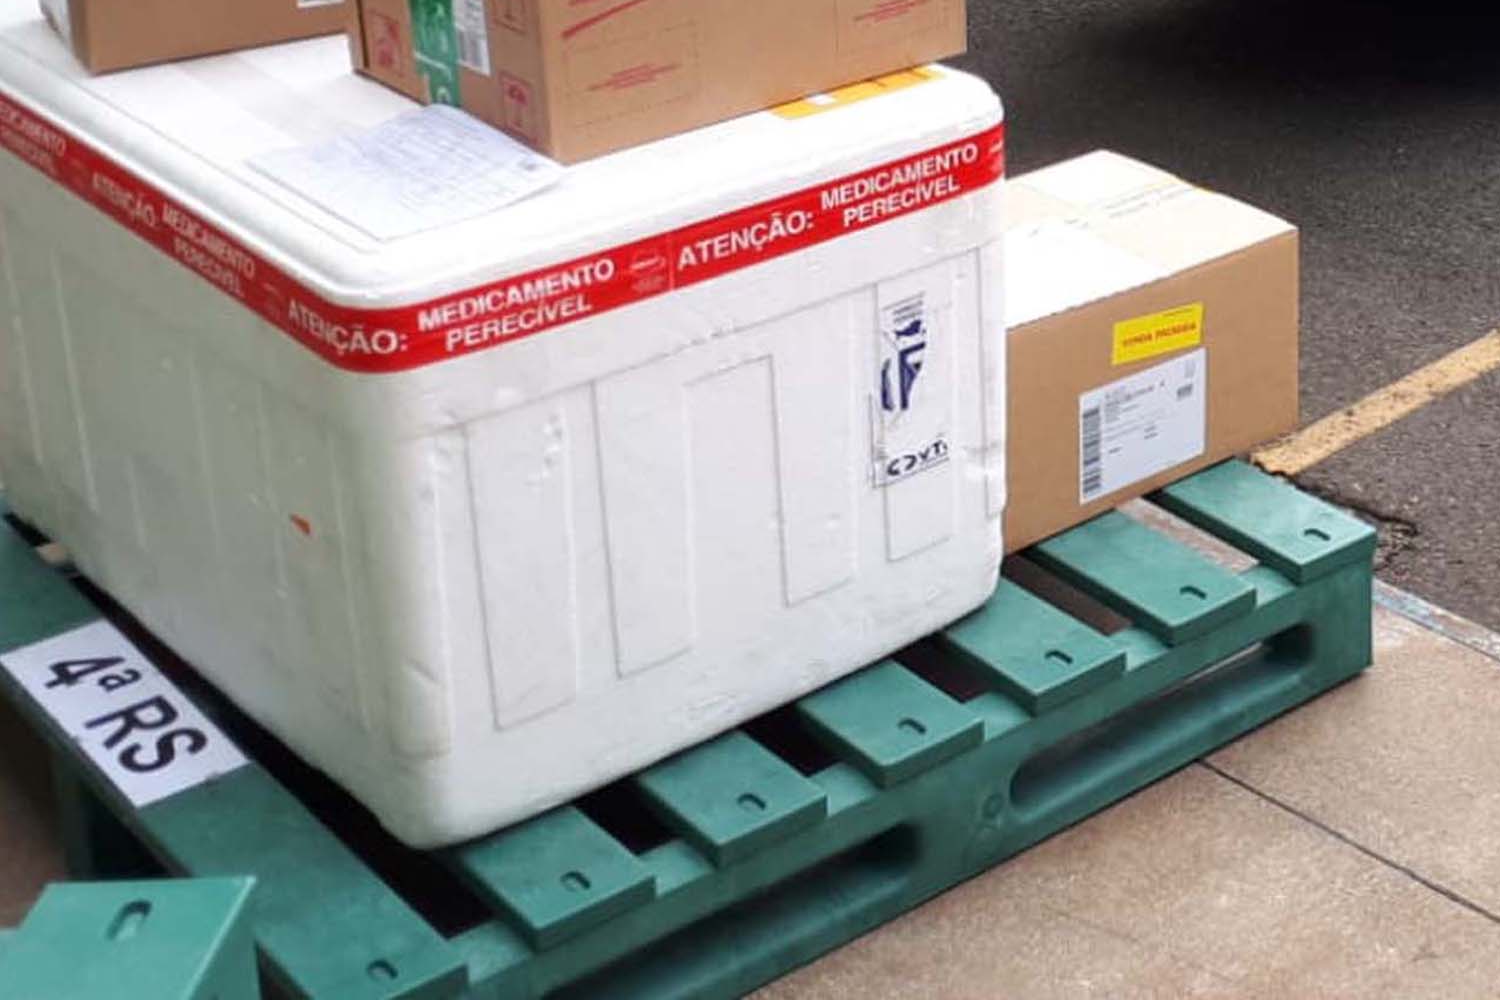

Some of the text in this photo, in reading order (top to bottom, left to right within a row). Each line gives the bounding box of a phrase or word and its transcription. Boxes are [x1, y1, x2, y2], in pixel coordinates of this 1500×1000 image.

[162, 201, 256, 280] MEDICAMENTO
[677, 143, 979, 271] ATENÇÃO: MEDICAMENTO
[842, 174, 961, 228] PERECÍVEL
[288, 300, 408, 357] ATENÇÃO:
[417, 258, 615, 332] MEDICAMENTO
[446, 293, 593, 352] PERECÍVEL
[84, 695, 208, 775] RS
